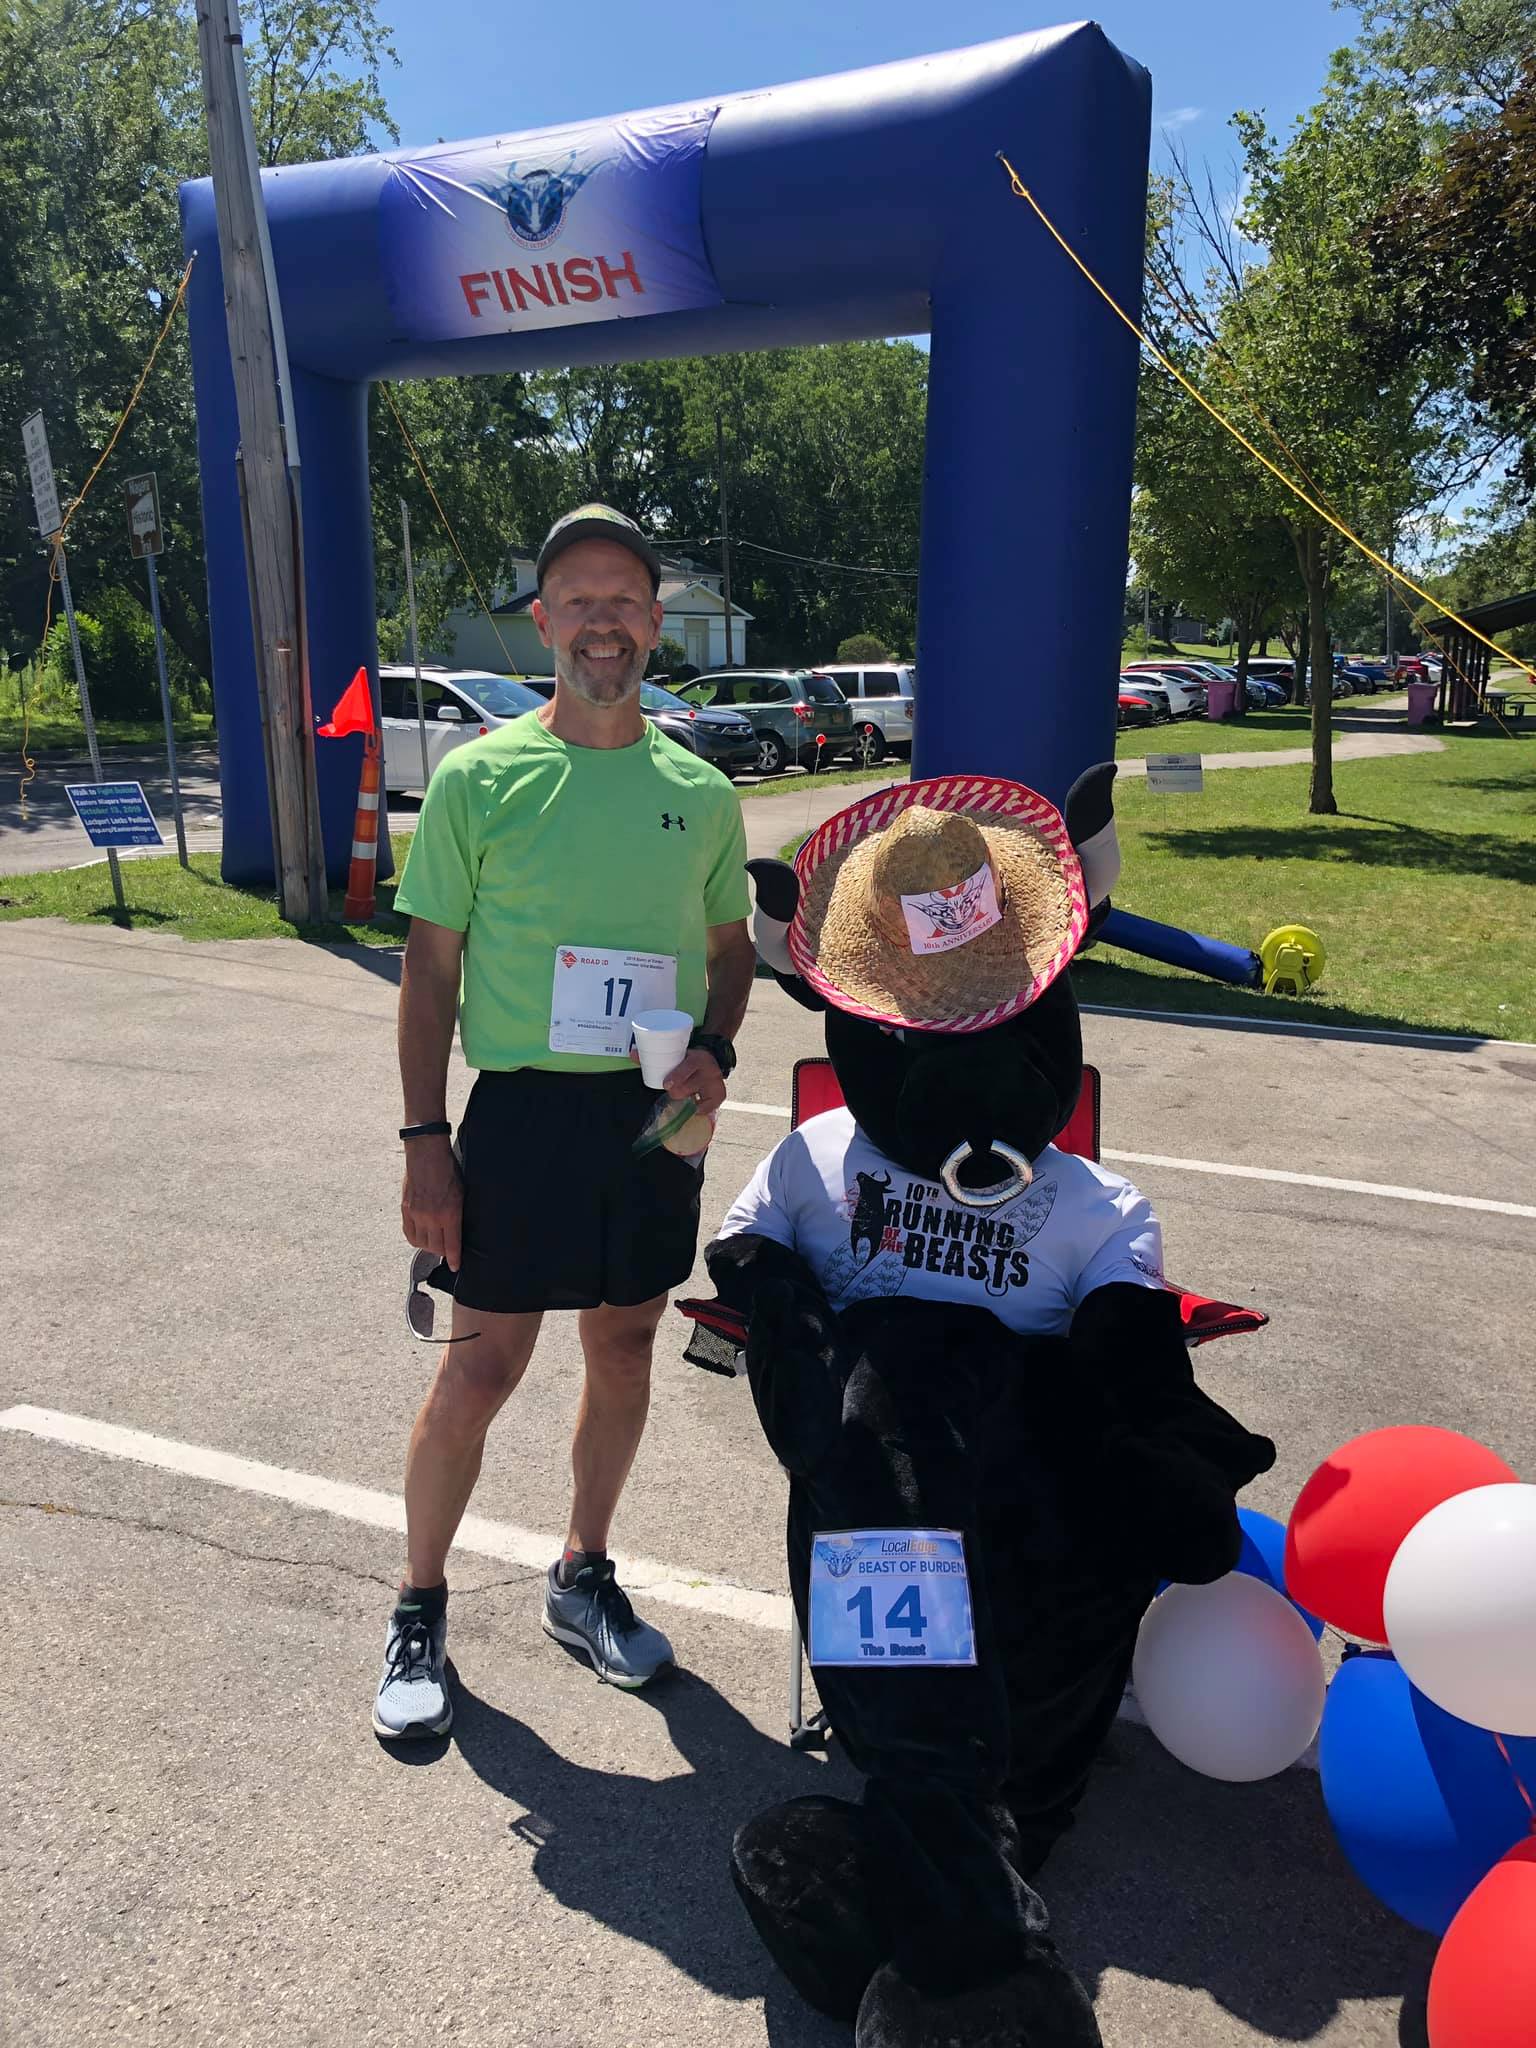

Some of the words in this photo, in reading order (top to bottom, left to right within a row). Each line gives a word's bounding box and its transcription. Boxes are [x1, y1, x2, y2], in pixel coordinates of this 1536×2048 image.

[459, 251, 646, 318] FINISH
[71, 788, 88, 796] Walk
[80, 806, 108, 815] October
[923, 942, 941, 950] 10th
[942, 917, 993, 948] ANNIVERSARY
[580, 957, 600, 966] ROAD
[604, 977, 633, 1017] 17
[905, 1182, 939, 1202] 10TH
[885, 1198, 1015, 1249] RUNNING
[884, 1226, 901, 1239] OF
[902, 1232, 1029, 1289] BEASTS
[881, 1539, 938, 1554] LocalEdge
[858, 1560, 896, 1574] BEAST
[900, 1560, 917, 1574] OF
[920, 1560, 964, 1574] BURDEN
[847, 1585, 927, 1639] 14
[861, 1643, 885, 1656] The
